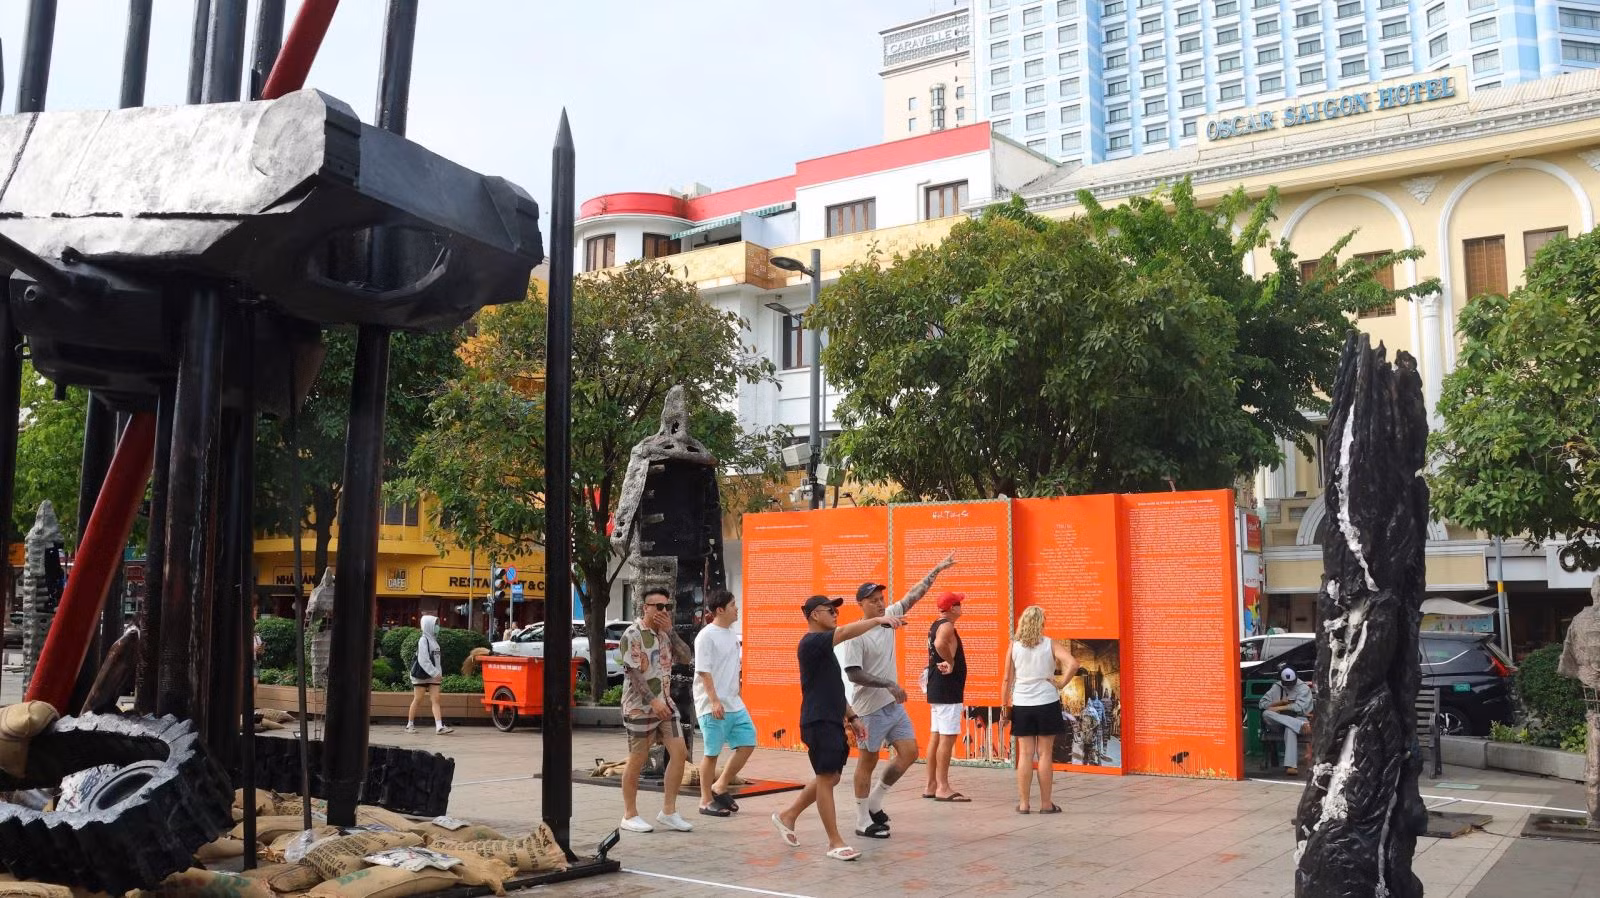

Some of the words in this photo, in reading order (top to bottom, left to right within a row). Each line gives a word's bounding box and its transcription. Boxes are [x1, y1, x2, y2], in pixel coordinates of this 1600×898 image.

[890, 30, 952, 53] CARAVELLE
[1206, 110, 1275, 141] OSCAR
[1283, 93, 1371, 127] SAIGON
[1378, 76, 1456, 110] HOTEL
